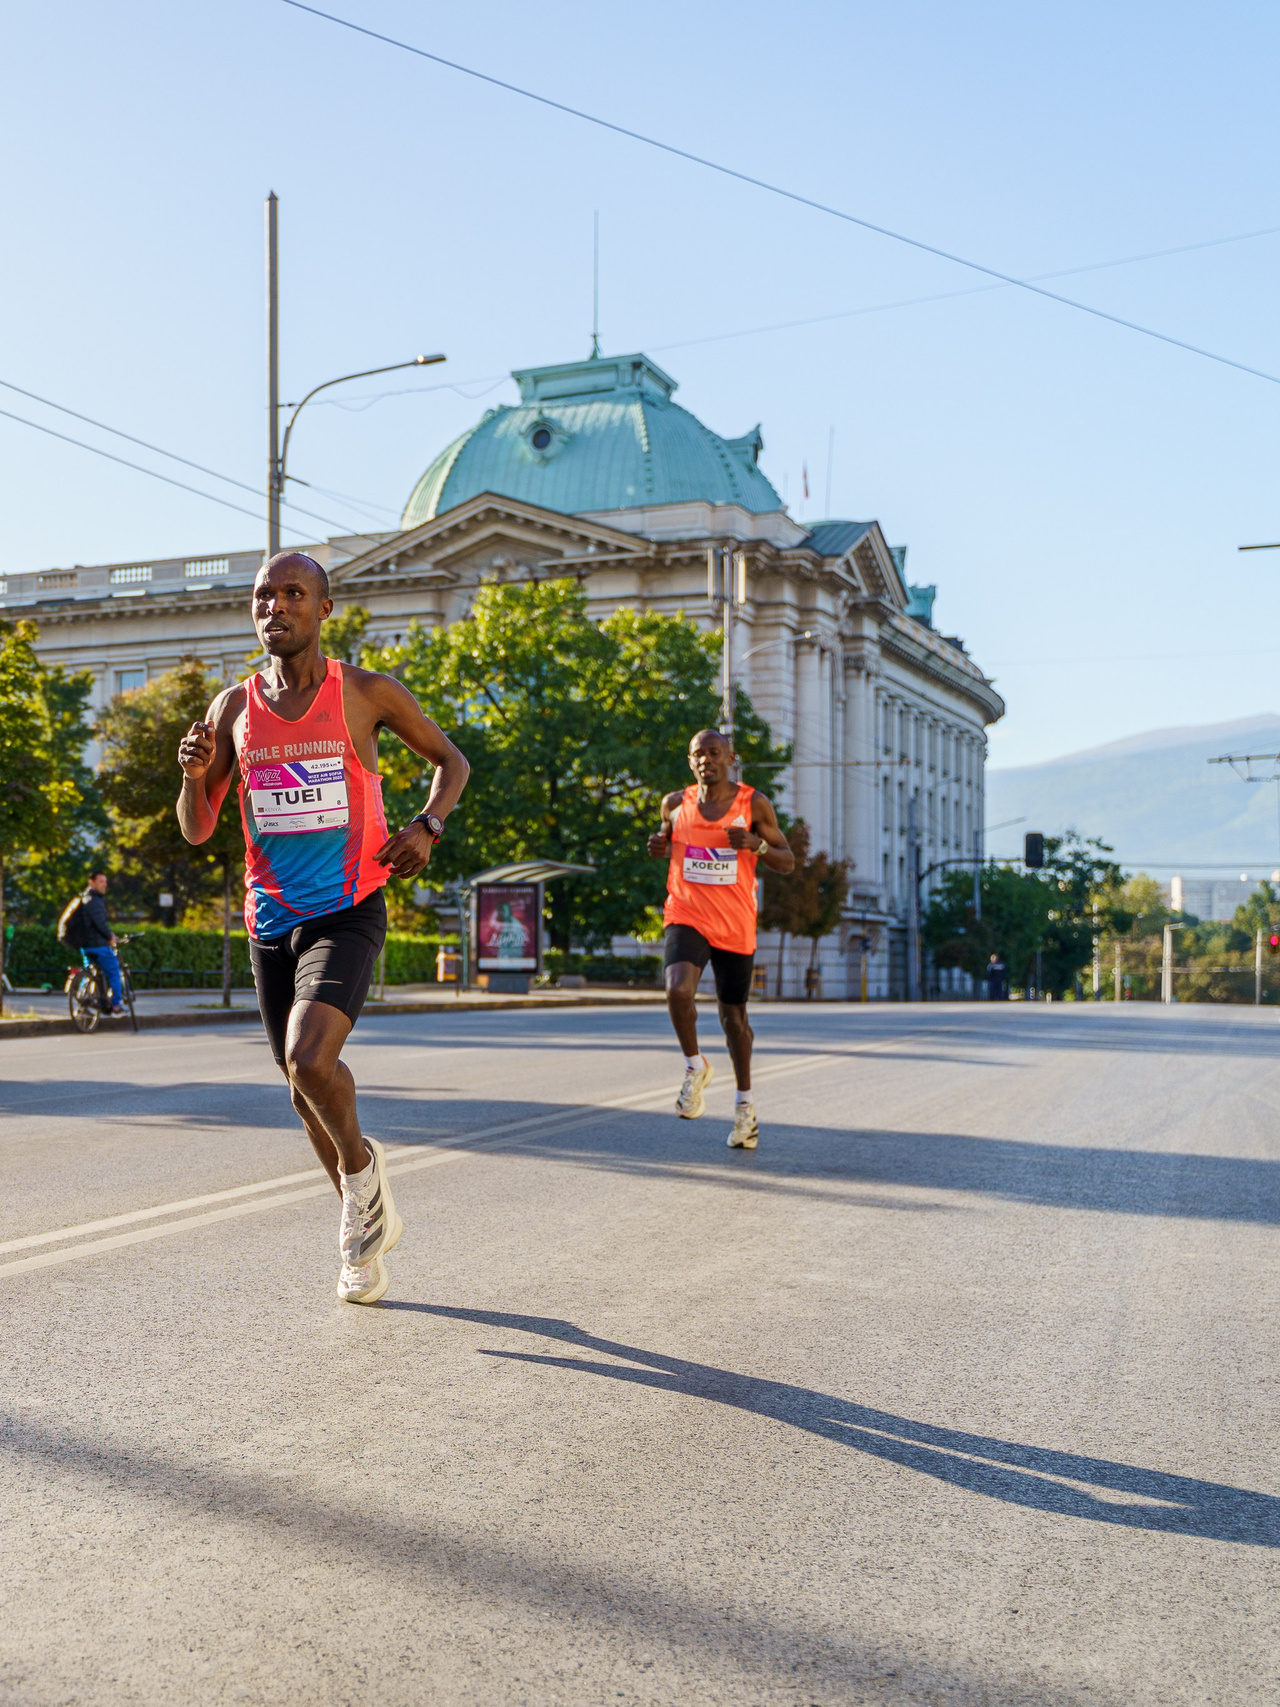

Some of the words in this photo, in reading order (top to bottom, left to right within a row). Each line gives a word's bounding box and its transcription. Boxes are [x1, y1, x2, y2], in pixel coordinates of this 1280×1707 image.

[283, 740, 345, 758] RUNNING
[310, 762, 330, 770] 42.195
[271, 787, 322, 806] TUEI
[692, 861, 729, 871] KOECH
